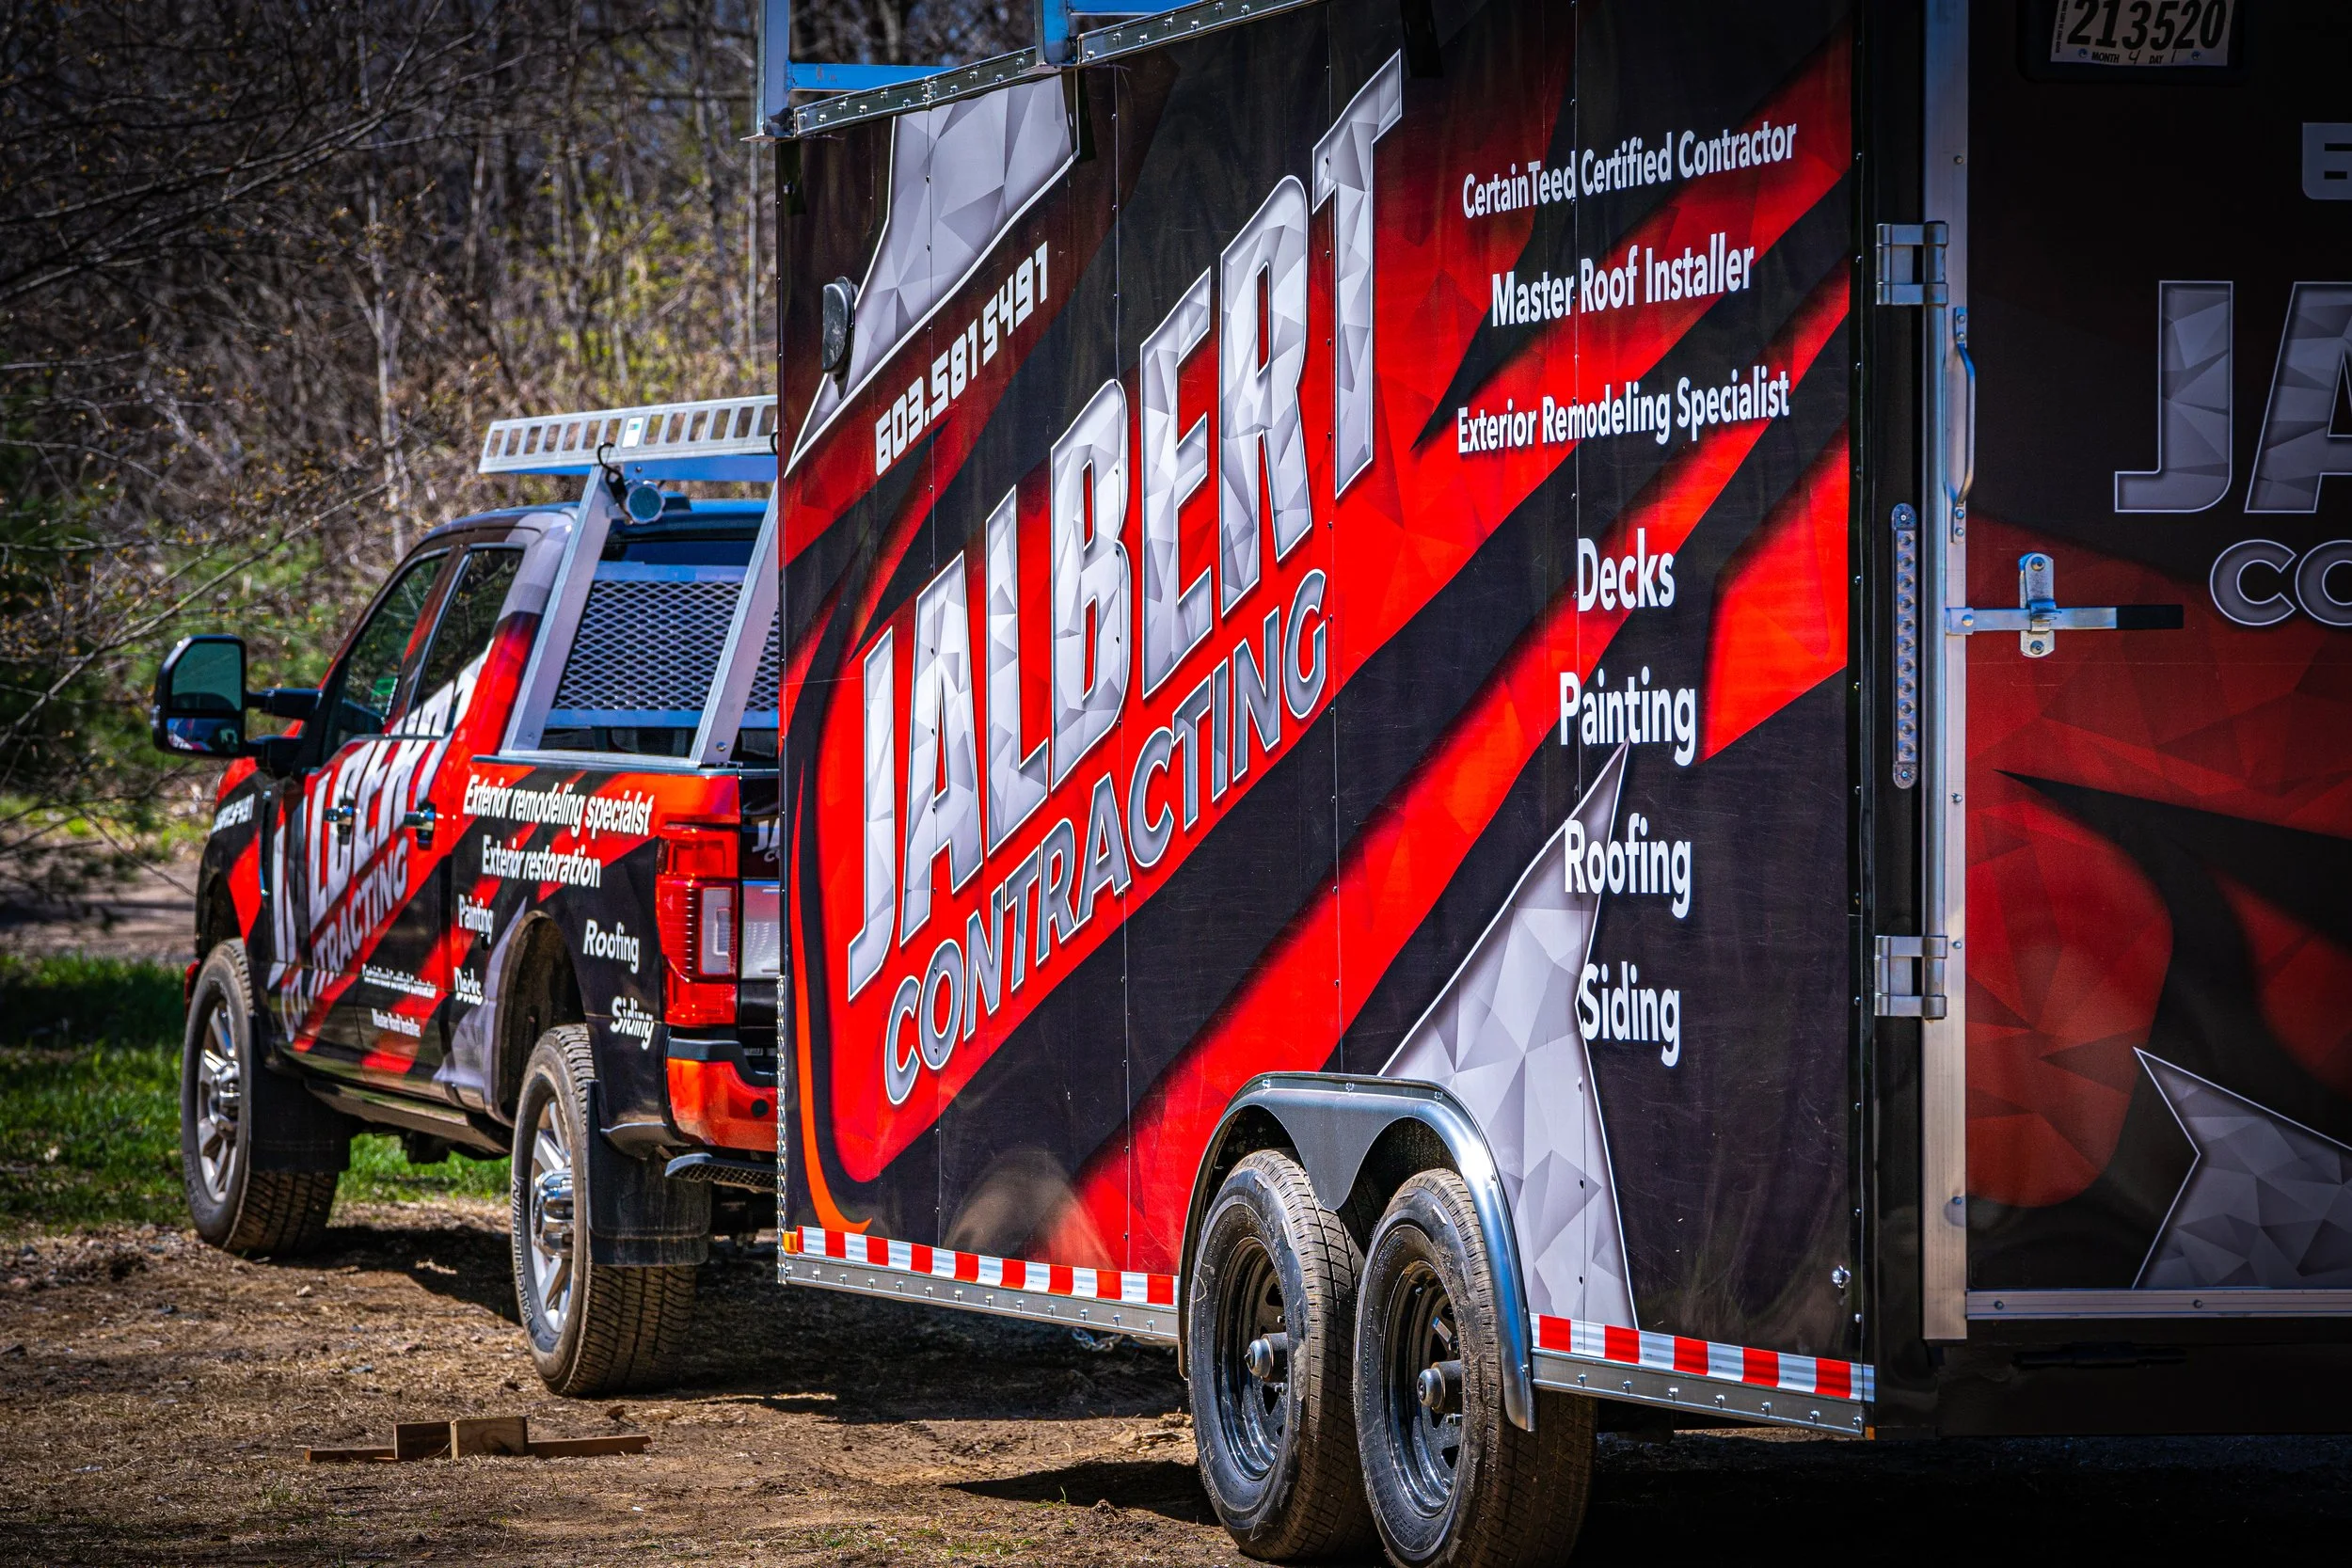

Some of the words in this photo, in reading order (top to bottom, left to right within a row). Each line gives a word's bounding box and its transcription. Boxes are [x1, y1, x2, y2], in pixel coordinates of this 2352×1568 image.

[2067, 0, 2227, 51] 213520
[2091, 51, 2121, 64] MONTH
[2128, 50, 2141, 65] 4
[2149, 55, 2165, 65] DAY
[1462, 150, 1576, 219] CertainTeed
[1581, 132, 1673, 197] Certified
[1677, 121, 1797, 179] Contractor
[1491, 262, 1575, 327] Master
[1581, 245, 1638, 312] Roof
[1645, 232, 1755, 303] Installer
[1456, 399, 1537, 454] Exterior
[1542, 382, 1671, 445] Remodeling
[1677, 365, 1789, 442] Specialist
[849, 50, 1403, 1003] JALBERT
[1576, 527, 1676, 613] Decks
[1559, 666, 1696, 768] Painting
[463, 774, 514, 818] Exterior
[509, 782, 587, 837] remodeling
[885, 568, 1326, 1105] CONTRACTING
[482, 834, 525, 877] Exterior
[522, 845, 602, 889] restoration
[1563, 813, 1692, 919] Roofing
[458, 894, 495, 944] Painting
[582, 918, 640, 974] Roofing
[610, 995, 655, 1051] Siding
[1579, 959, 1681, 1068] Siding
